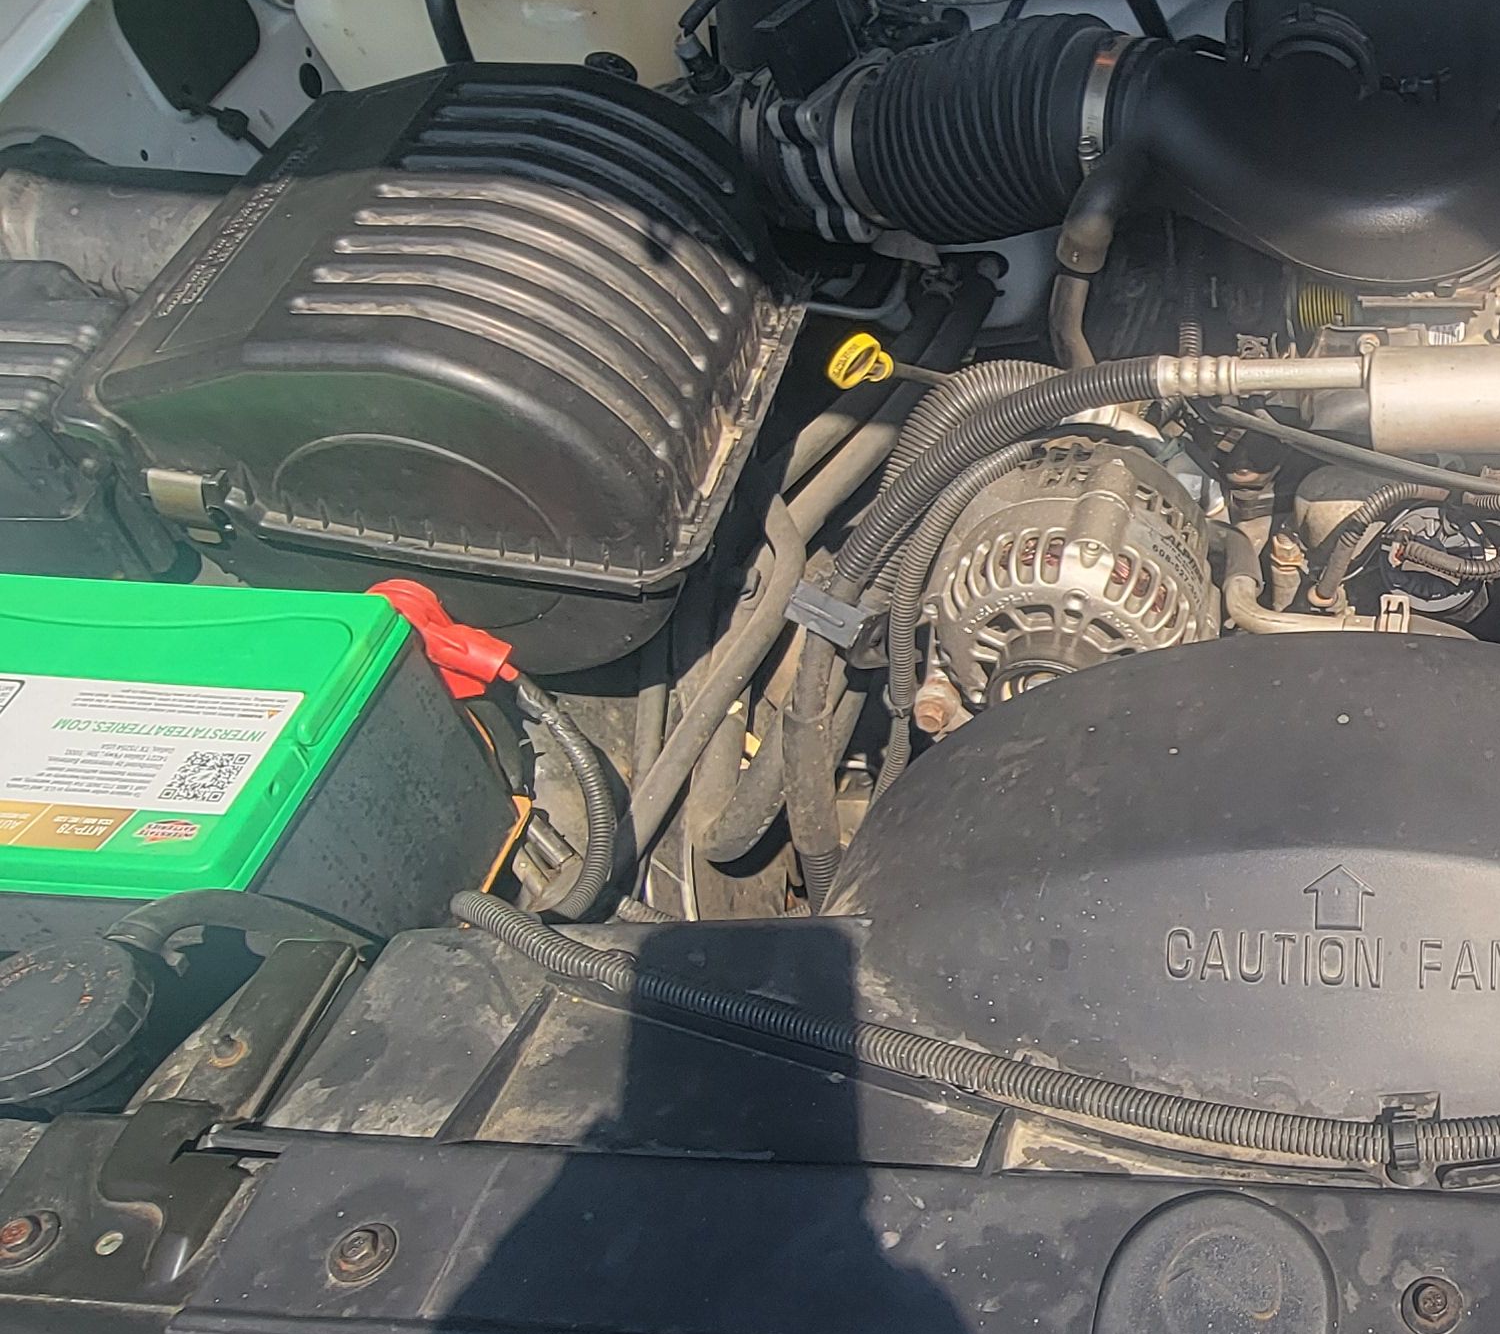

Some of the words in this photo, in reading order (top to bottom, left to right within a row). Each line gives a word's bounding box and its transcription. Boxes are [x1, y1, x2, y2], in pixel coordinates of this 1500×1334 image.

[50, 718, 267, 742] INTERSTATEBATTERIES.COM
[56, 823, 107, 836] MTP-78
[1165, 927, 1382, 989] CAUTION
